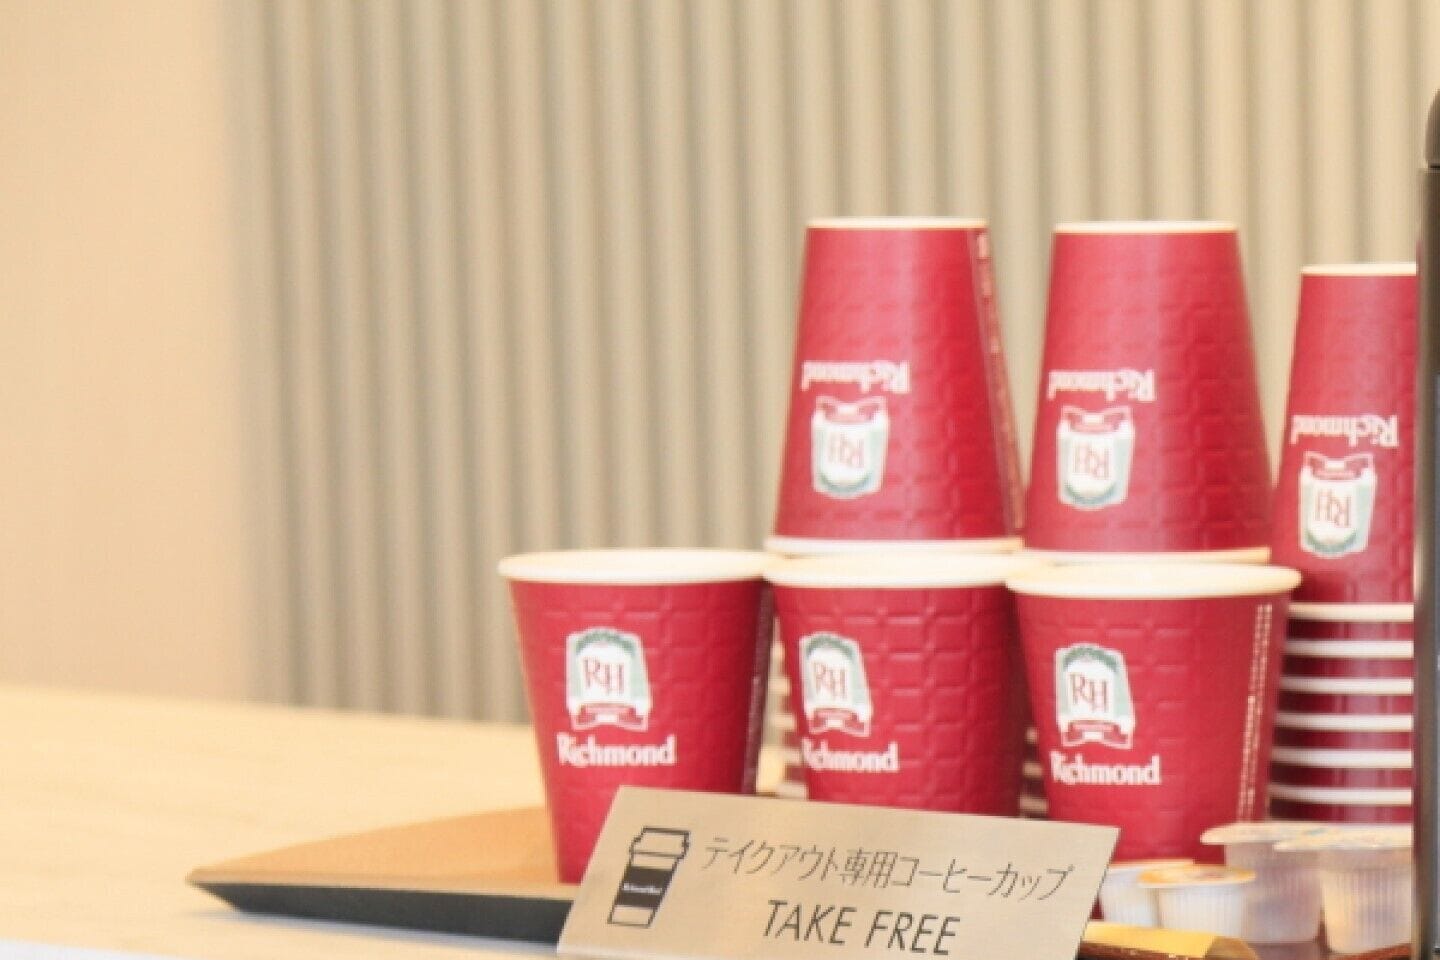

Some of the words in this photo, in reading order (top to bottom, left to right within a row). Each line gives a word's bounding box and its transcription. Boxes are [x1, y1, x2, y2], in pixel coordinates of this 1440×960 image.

[801, 360, 911, 394] Richmond
[1048, 369, 1156, 403] Richmond
[1291, 415, 1399, 447] Richmond
[584, 658, 625, 696] RH
[813, 661, 847, 699] RH
[1070, 672, 1109, 712] RH
[556, 731, 677, 768] Richmond
[801, 737, 899, 773] Richmond
[1050, 750, 1162, 786] Richmond
[701, 837, 1076, 901] テイクアウト専用コーヒーカップ
[763, 899, 858, 945] TAKE
[864, 909, 961, 955] FREE
